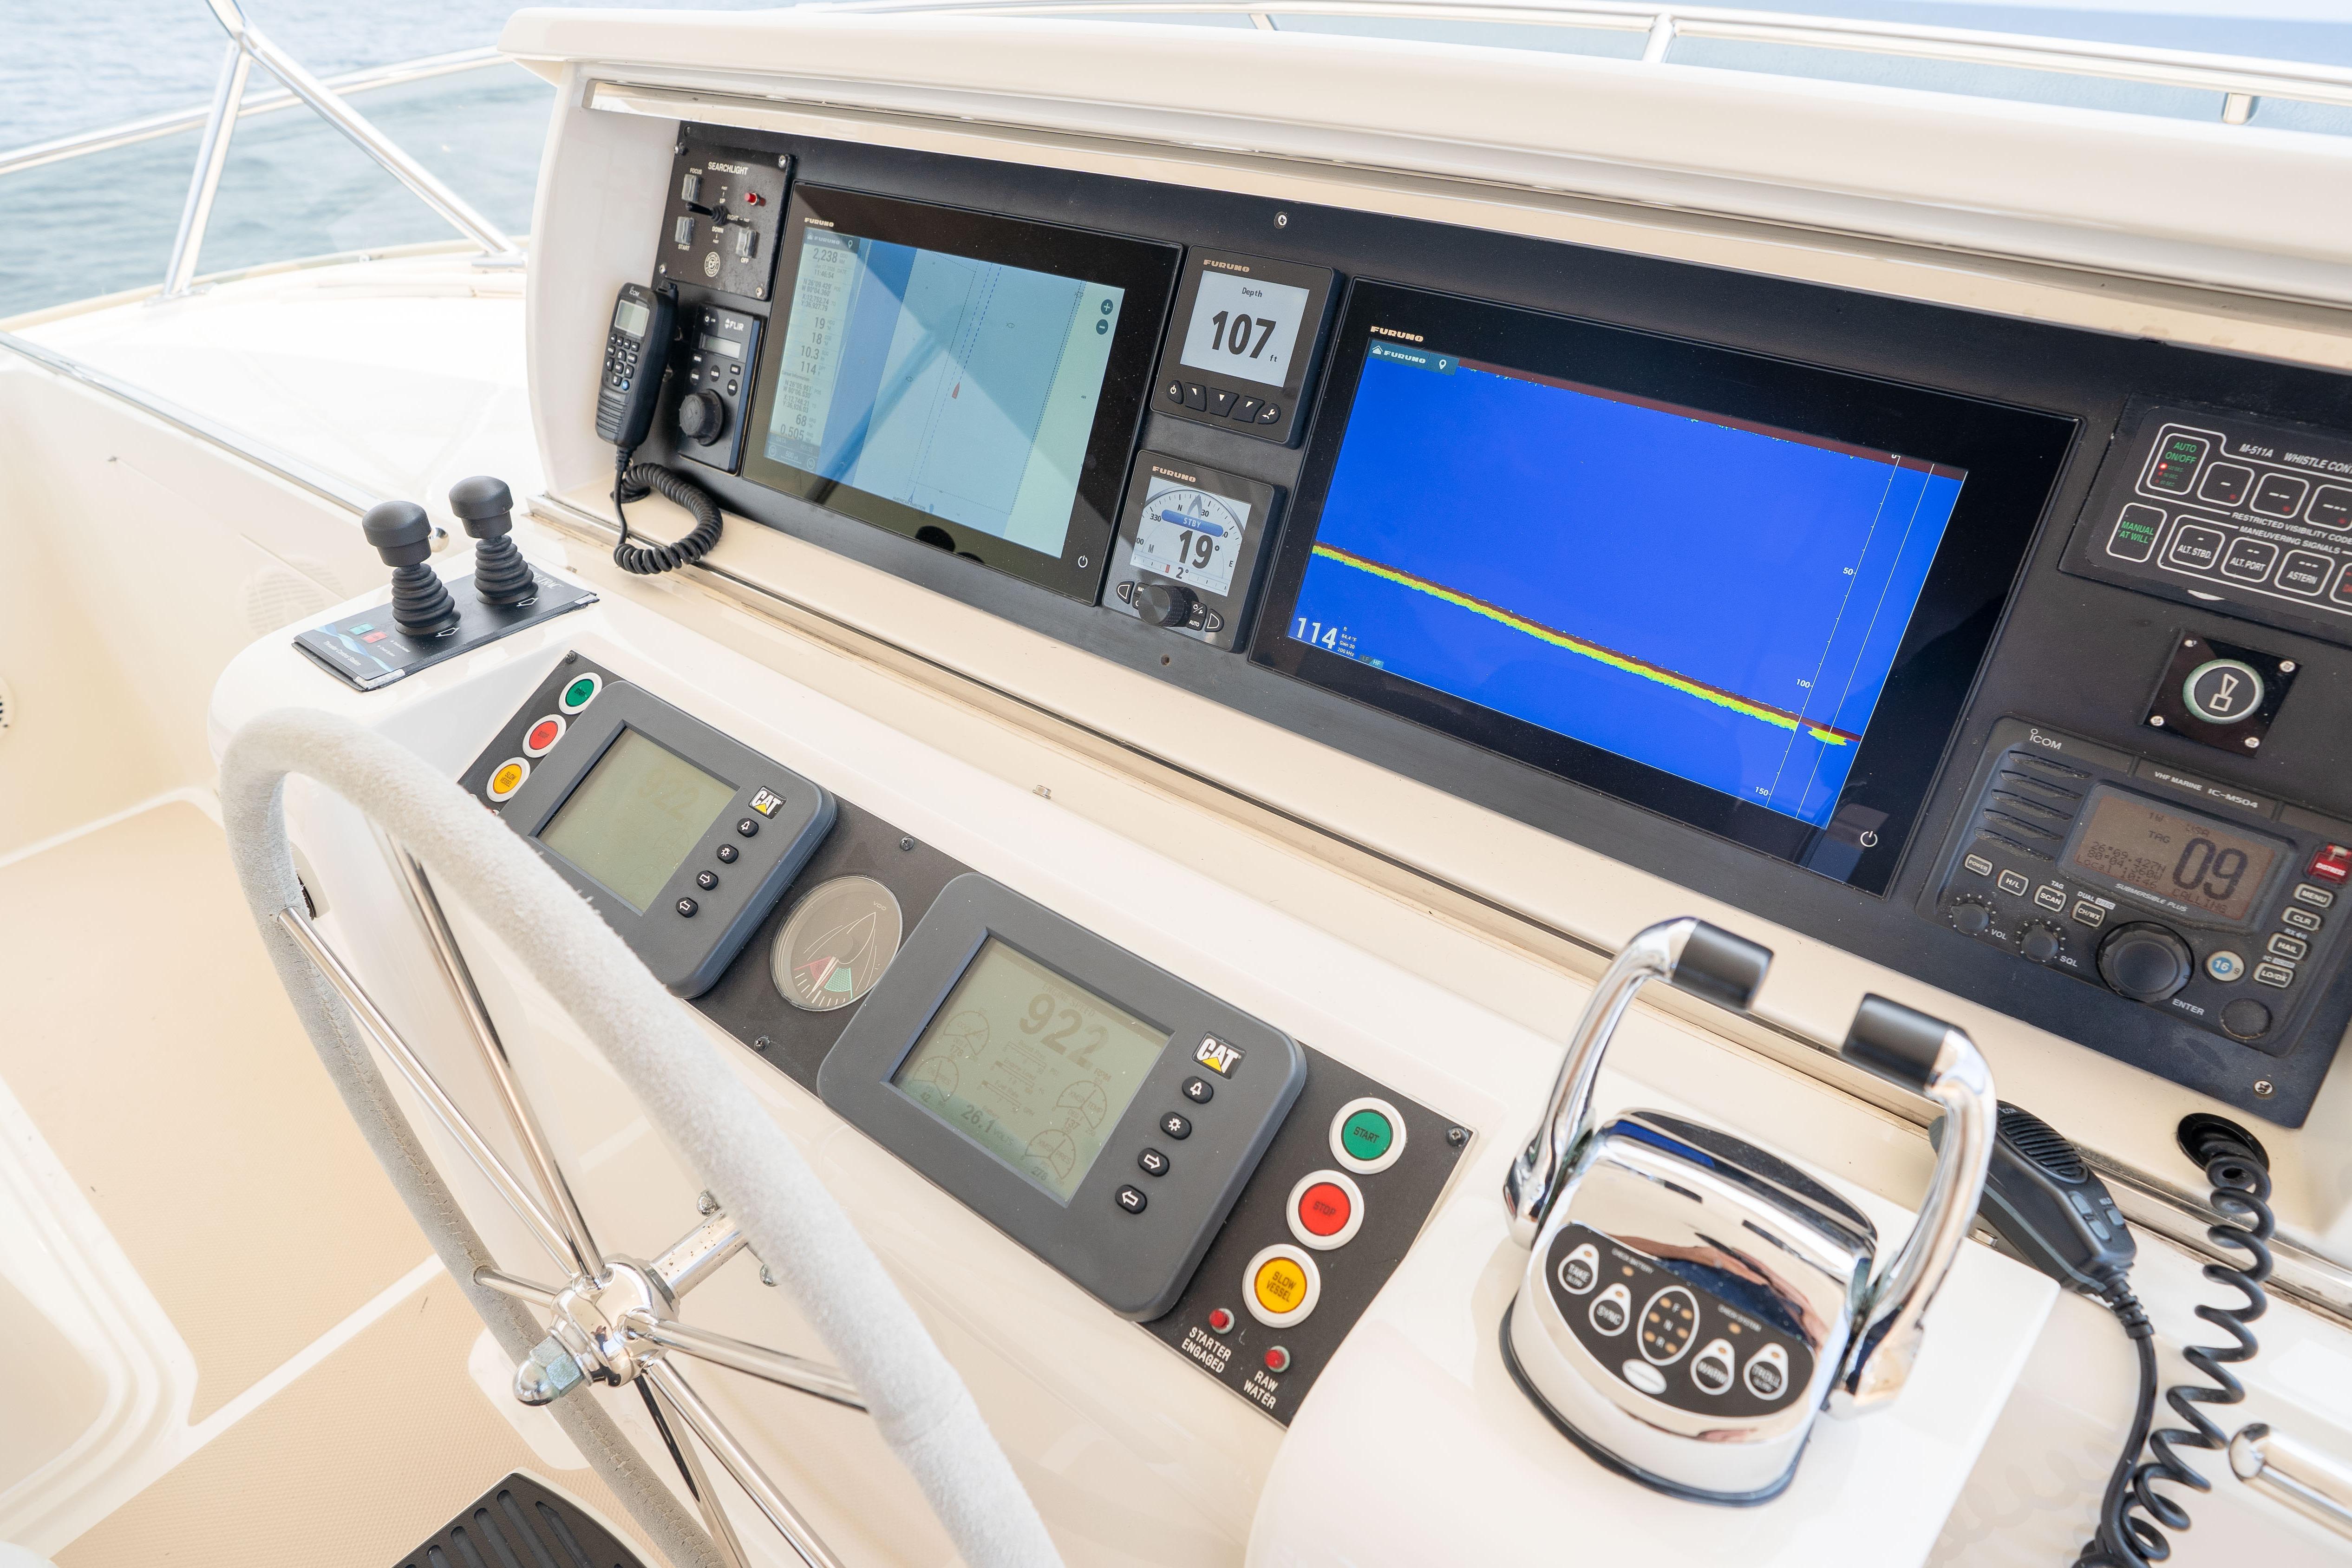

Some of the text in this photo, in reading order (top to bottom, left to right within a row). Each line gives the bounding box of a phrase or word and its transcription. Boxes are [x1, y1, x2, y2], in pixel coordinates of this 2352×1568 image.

[707, 162, 748, 175] SEARCHLIGHT
[804, 217, 834, 227] FURUNO
[814, 236, 840, 245] FURUNO
[813, 248, 838, 263] 2,238
[1203, 259, 1250, 272] FURUNO
[814, 269, 835, 279] 11:46:54
[1242, 287, 1262, 297] Depth
[729, 320, 744, 331] FLIR
[815, 317, 825, 329] 19
[812, 332, 822, 345] 18
[1212, 310, 1276, 359] 107
[1371, 326, 1424, 342] FURUNO
[801, 345, 819, 360] 10.3
[1384, 350, 1426, 364] FURUNO
[801, 361, 817, 375] 114
[796, 414, 807, 426] 68
[781, 424, 804, 441] 0.505
[2173, 442, 2197, 453] AUTO
[2165, 451, 2197, 464] ON/OFF
[2239, 444, 2274, 457] M-511A
[2284, 452, 2328, 468] WHISTLE
[1152, 465, 1196, 483] FURUNO
[1150, 513, 1161, 522] 330
[1183, 518, 1201, 528] STBY
[2121, 521, 2154, 535] MANUAL
[2231, 512, 2284, 529] RESTRICTED
[2285, 524, 2328, 539] VISIBILITY
[2239, 526, 2341, 554] MANEUVERING SIGNALS
[1148, 544, 1155, 554] M
[2176, 544, 2211, 559] ALT. STBD.
[2229, 557, 2266, 571] ALT. PORT
[1842, 567, 1853, 576] 50
[2287, 571, 2318, 584] ASTERN
[1297, 617, 1337, 649] 114
[336, 649, 361, 666] Control Station
[1796, 678, 1810, 688] 100
[500, 777, 511, 787] VESSEL
[505, 771, 516, 780] SLOW
[1754, 787, 1769, 797] 150
[2154, 771, 2258, 808] VHF MARINE IC-M504
[752, 790, 781, 815] CAT
[2149, 812, 2164, 822] 1W
[2185, 823, 2210, 836] USA
[2148, 830, 2171, 843] TAG
[1968, 860, 1988, 871] POWER
[2076, 855, 2157, 889] Local 10:46
[2172, 837, 2248, 901] 09
[2006, 878, 2019, 889] H/L
[2051, 880, 2064, 889] TAG
[2039, 893, 2062, 905] SCAN
[2077, 891, 2095, 902] DUAL
[2114, 883, 2188, 912] SUBMERSIBLE PLUS
[2172, 888, 2228, 914] CALLING
[2301, 890, 2328, 903] MENU
[874, 901, 886, 911] VDO
[2077, 908, 2102, 921] CH/WX
[2293, 915, 2312, 925] CLR
[1992, 929, 2007, 940] VOL
[2278, 942, 2297, 954] HAIL
[2060, 955, 2078, 967] SQL
[2215, 960, 2229, 971] 16
[2261, 970, 2287, 982] LO/DX
[1042, 983, 1095, 1017] ENGINE SPEED
[2172, 999, 2205, 1015] ENTER
[1019, 993, 1109, 1071] 922
[1196, 1038, 1239, 1073] CAT
[1022, 1069, 1036, 1080] Load
[1094, 1068, 1112, 1082] RPM
[1087, 1102, 1103, 1113] TEMP
[961, 1104, 995, 1133] 26.1
[1065, 1117, 1080, 1130] 137
[993, 1129, 1014, 1146] VOLTS
[1353, 1126, 1380, 1144] START
[1055, 1150, 1071, 1164] PRES
[1031, 1166, 1048, 1181] 278
[1313, 1201, 1336, 1216] STOP
[1568, 1263, 1591, 1282] TAKE
[1272, 1272, 1296, 1290] SLOW
[1267, 1280, 1291, 1303] VESSEL
[1597, 1305, 1622, 1325] SYNC
[1189, 1326, 1231, 1362] STARTER
[1182, 1338, 1225, 1373] ENGAGED
[1254, 1370, 1278, 1392] RAW
[1243, 1379, 1276, 1409] WATER
